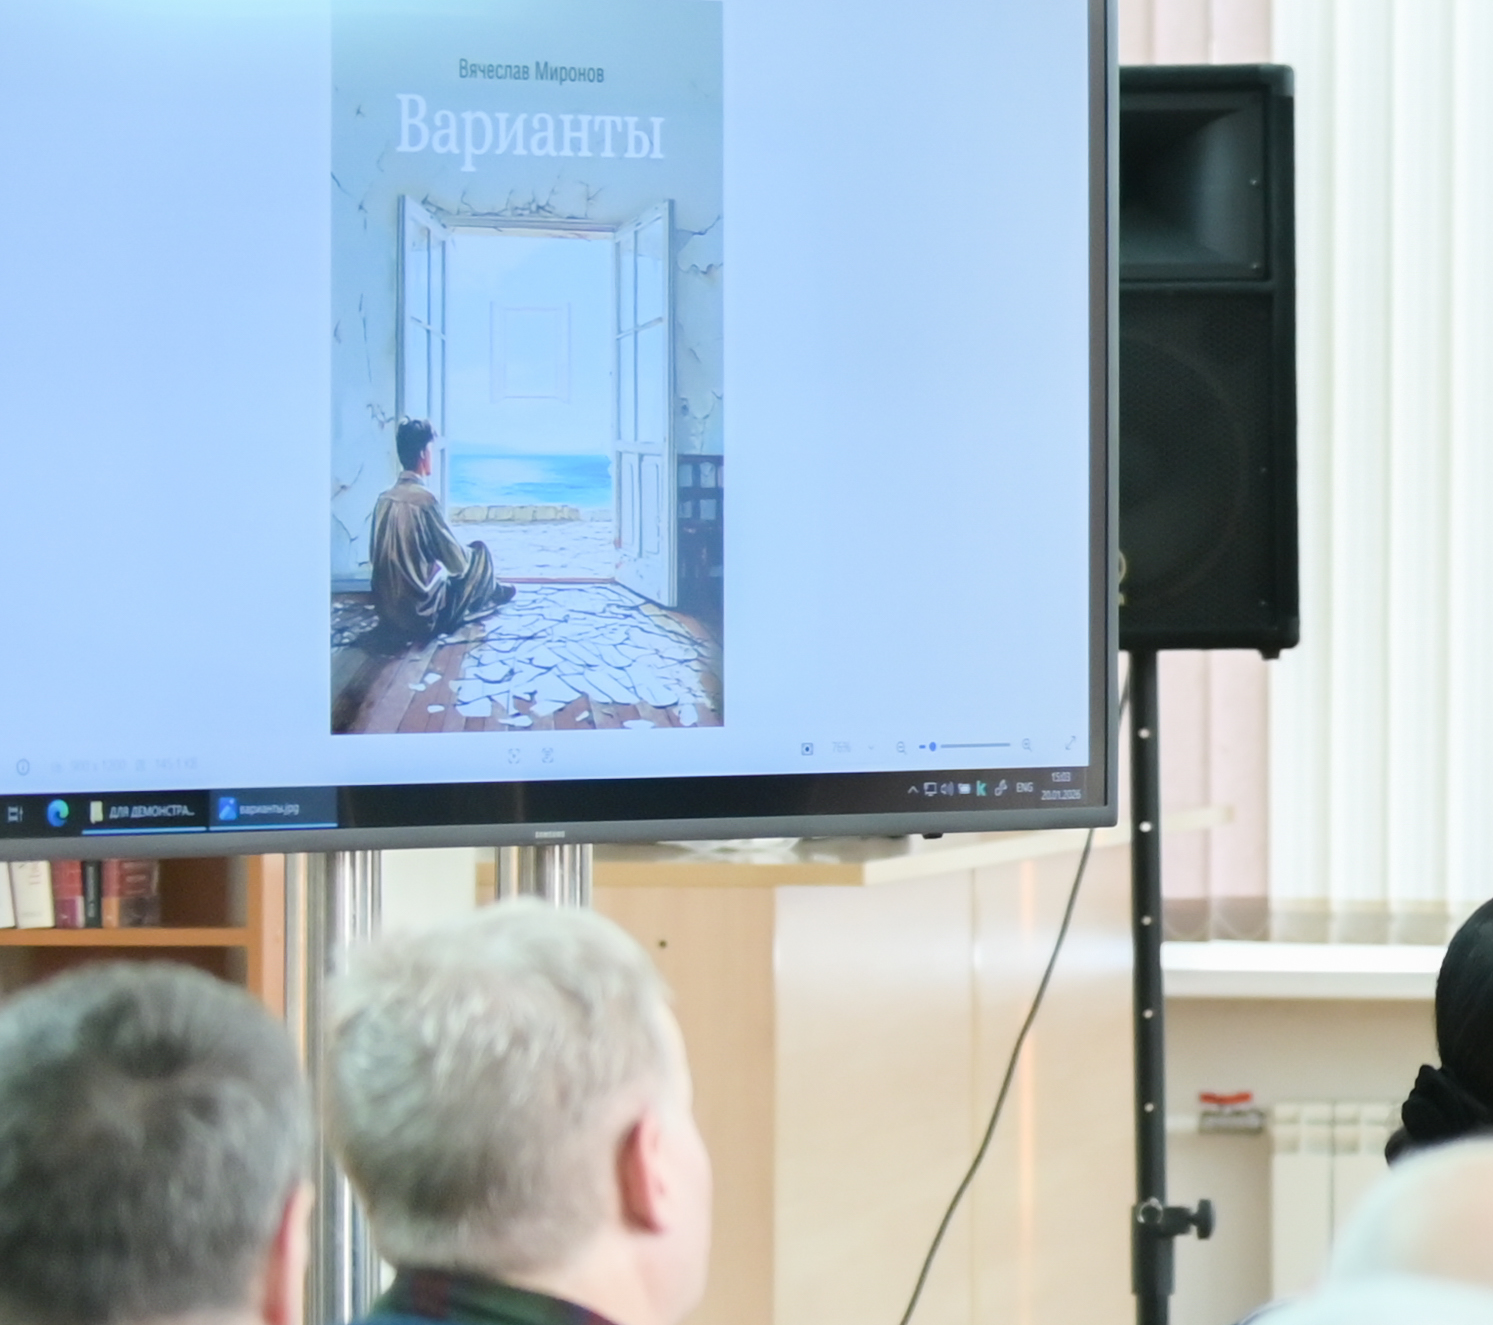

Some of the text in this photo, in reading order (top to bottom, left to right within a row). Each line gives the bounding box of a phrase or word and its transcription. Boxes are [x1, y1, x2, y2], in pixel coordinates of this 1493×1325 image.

[459, 58, 605, 85] Вячеслав Миронов
[395, 93, 665, 172] Варианты
[1016, 782, 1033, 793] ENG
[109, 806, 129, 819] ДЛЯ
